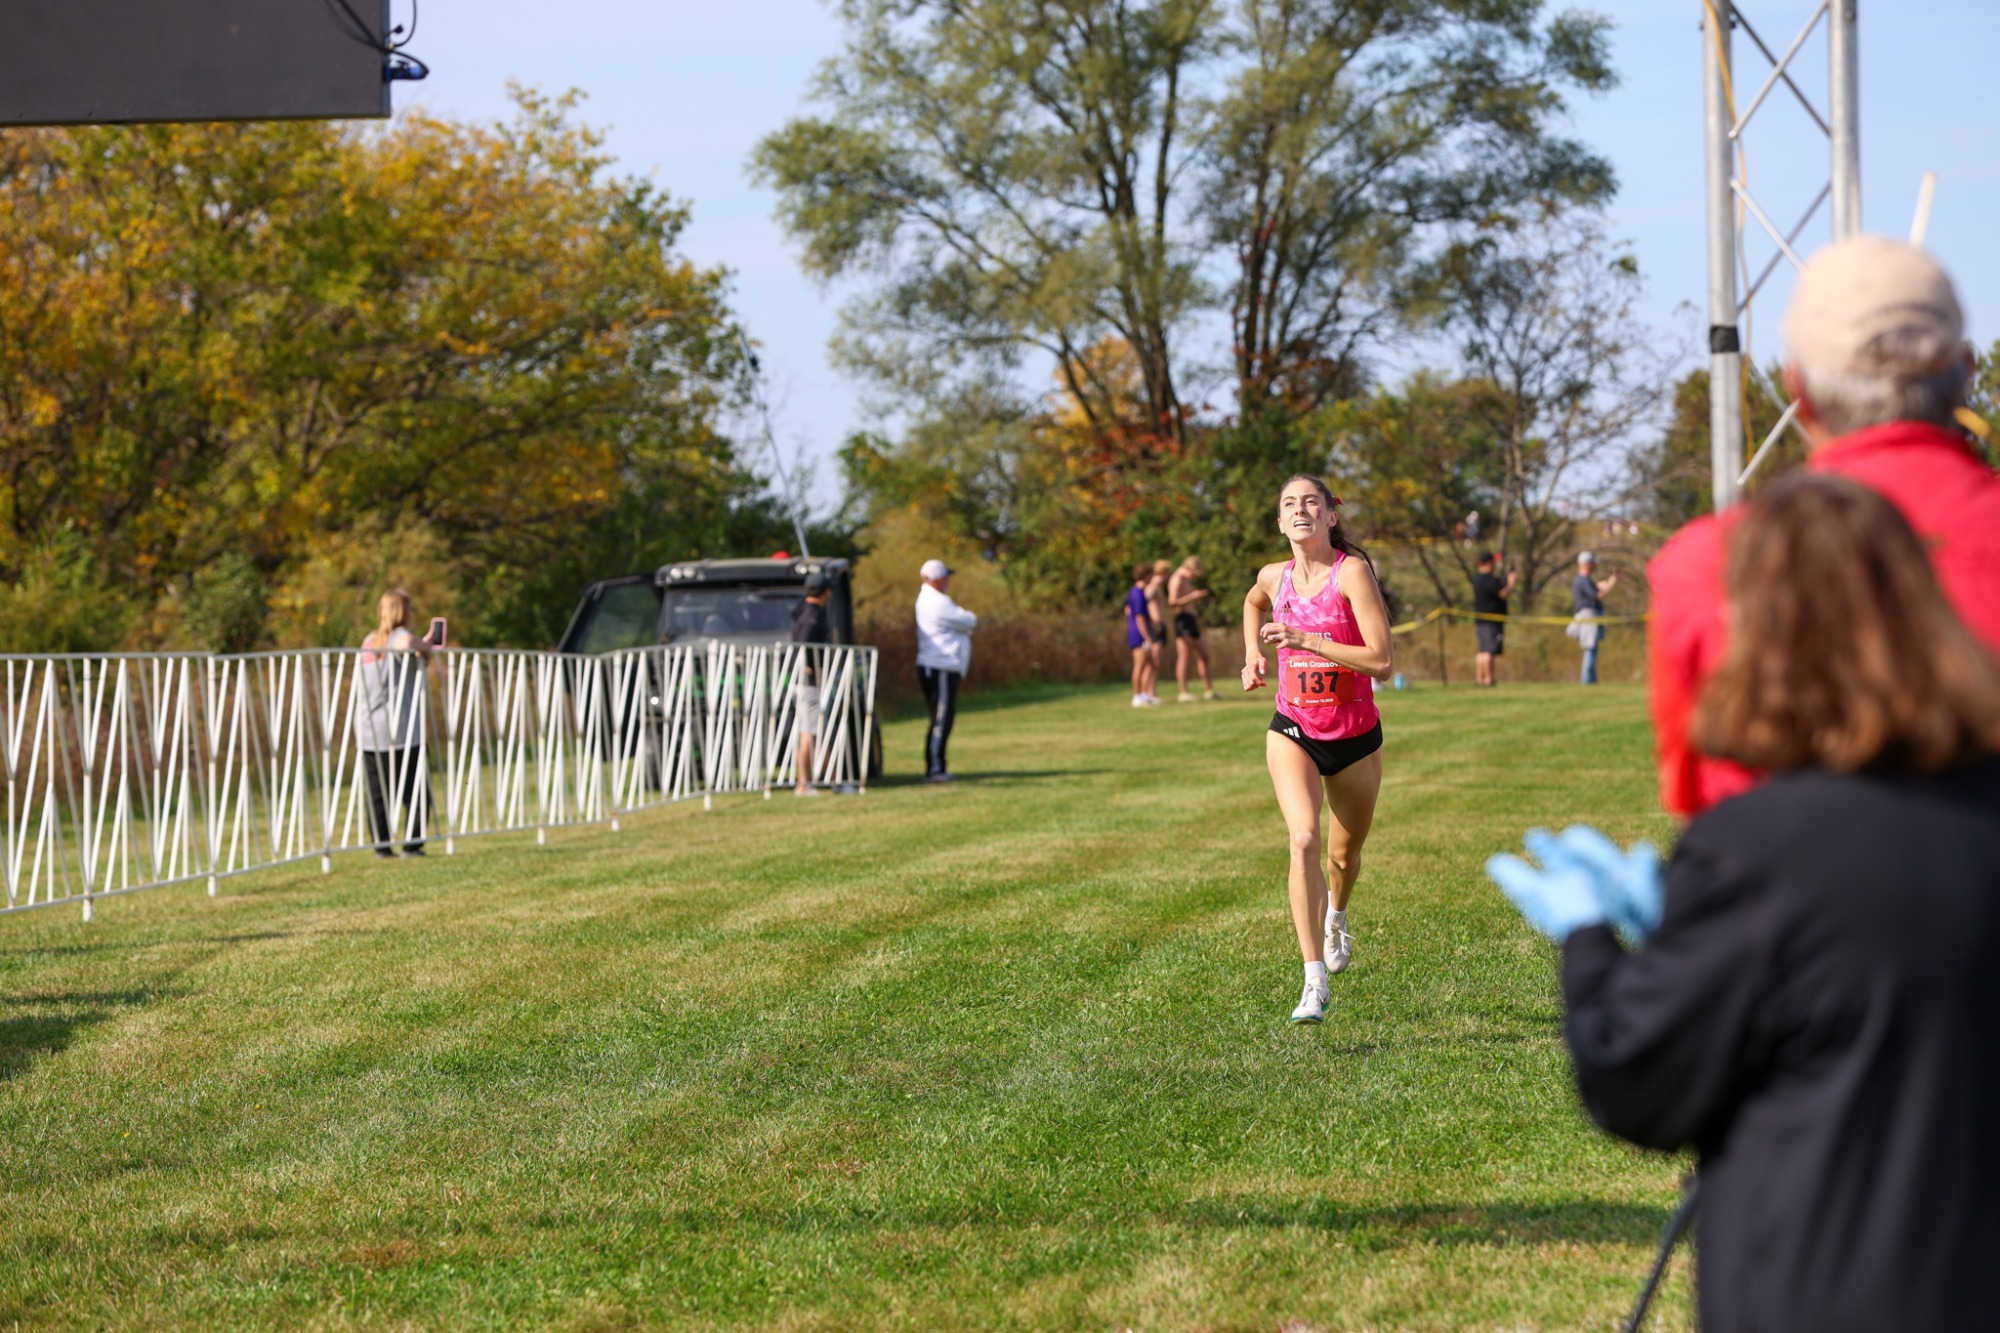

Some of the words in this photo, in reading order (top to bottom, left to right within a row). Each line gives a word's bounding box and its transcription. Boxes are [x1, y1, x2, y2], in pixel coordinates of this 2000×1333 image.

[1289, 660, 1308, 668] Lewis
[1309, 660, 1341, 668] Crossov
[1298, 671, 1339, 694] 137
